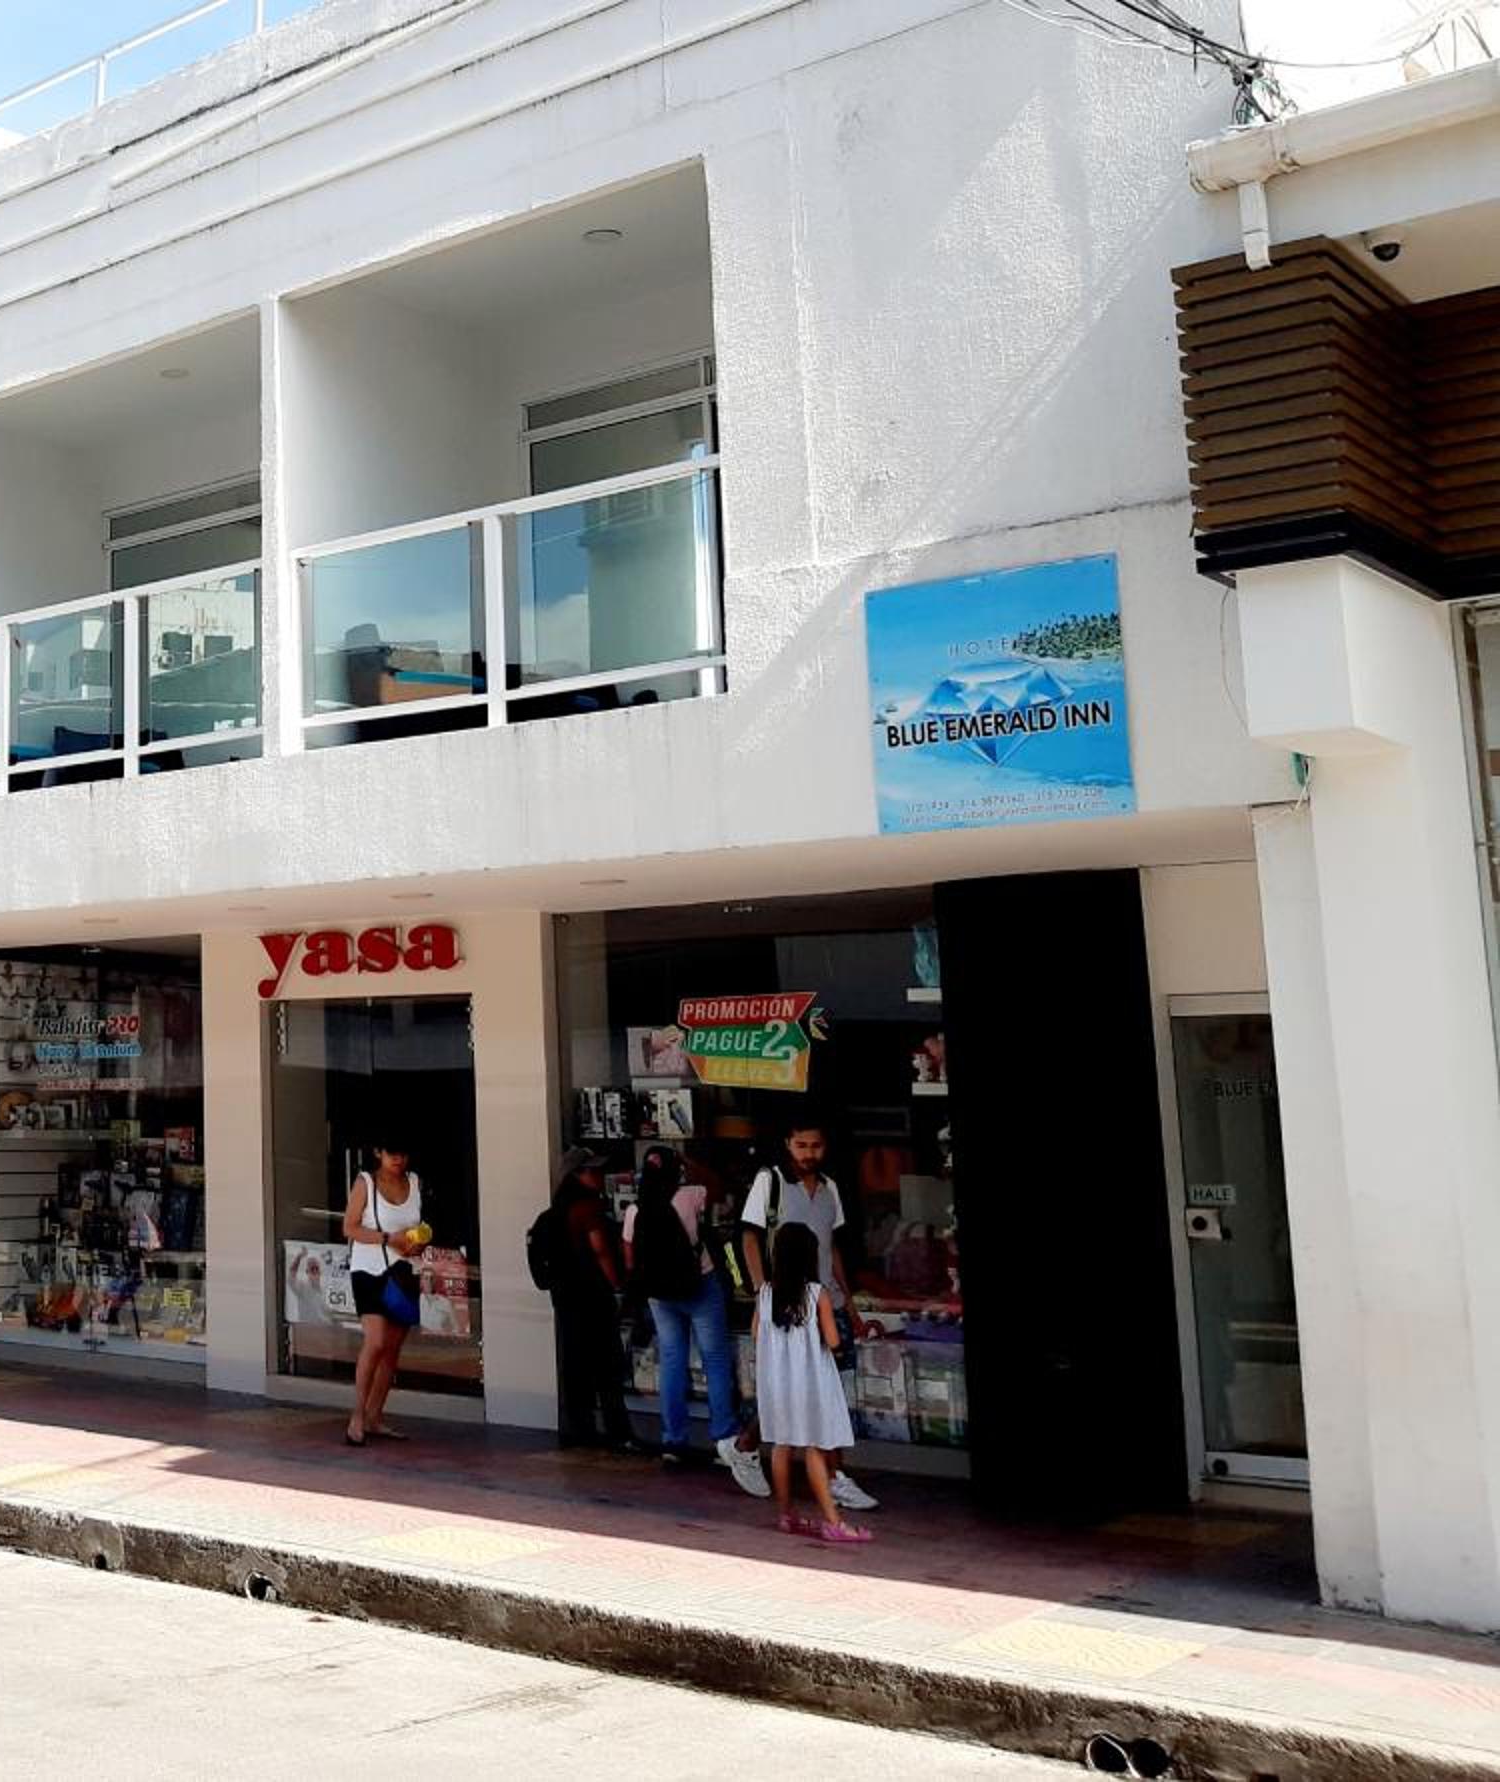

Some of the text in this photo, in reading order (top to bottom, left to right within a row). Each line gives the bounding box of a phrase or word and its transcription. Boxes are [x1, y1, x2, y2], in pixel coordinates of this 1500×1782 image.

[887, 700, 1111, 748] BLUE EMERALD INN
[257, 924, 463, 998] yasa
[683, 999, 796, 1021] PROMOCION
[691, 1019, 788, 1057] PAGUE 2
[1193, 1187, 1232, 1201] HALE
